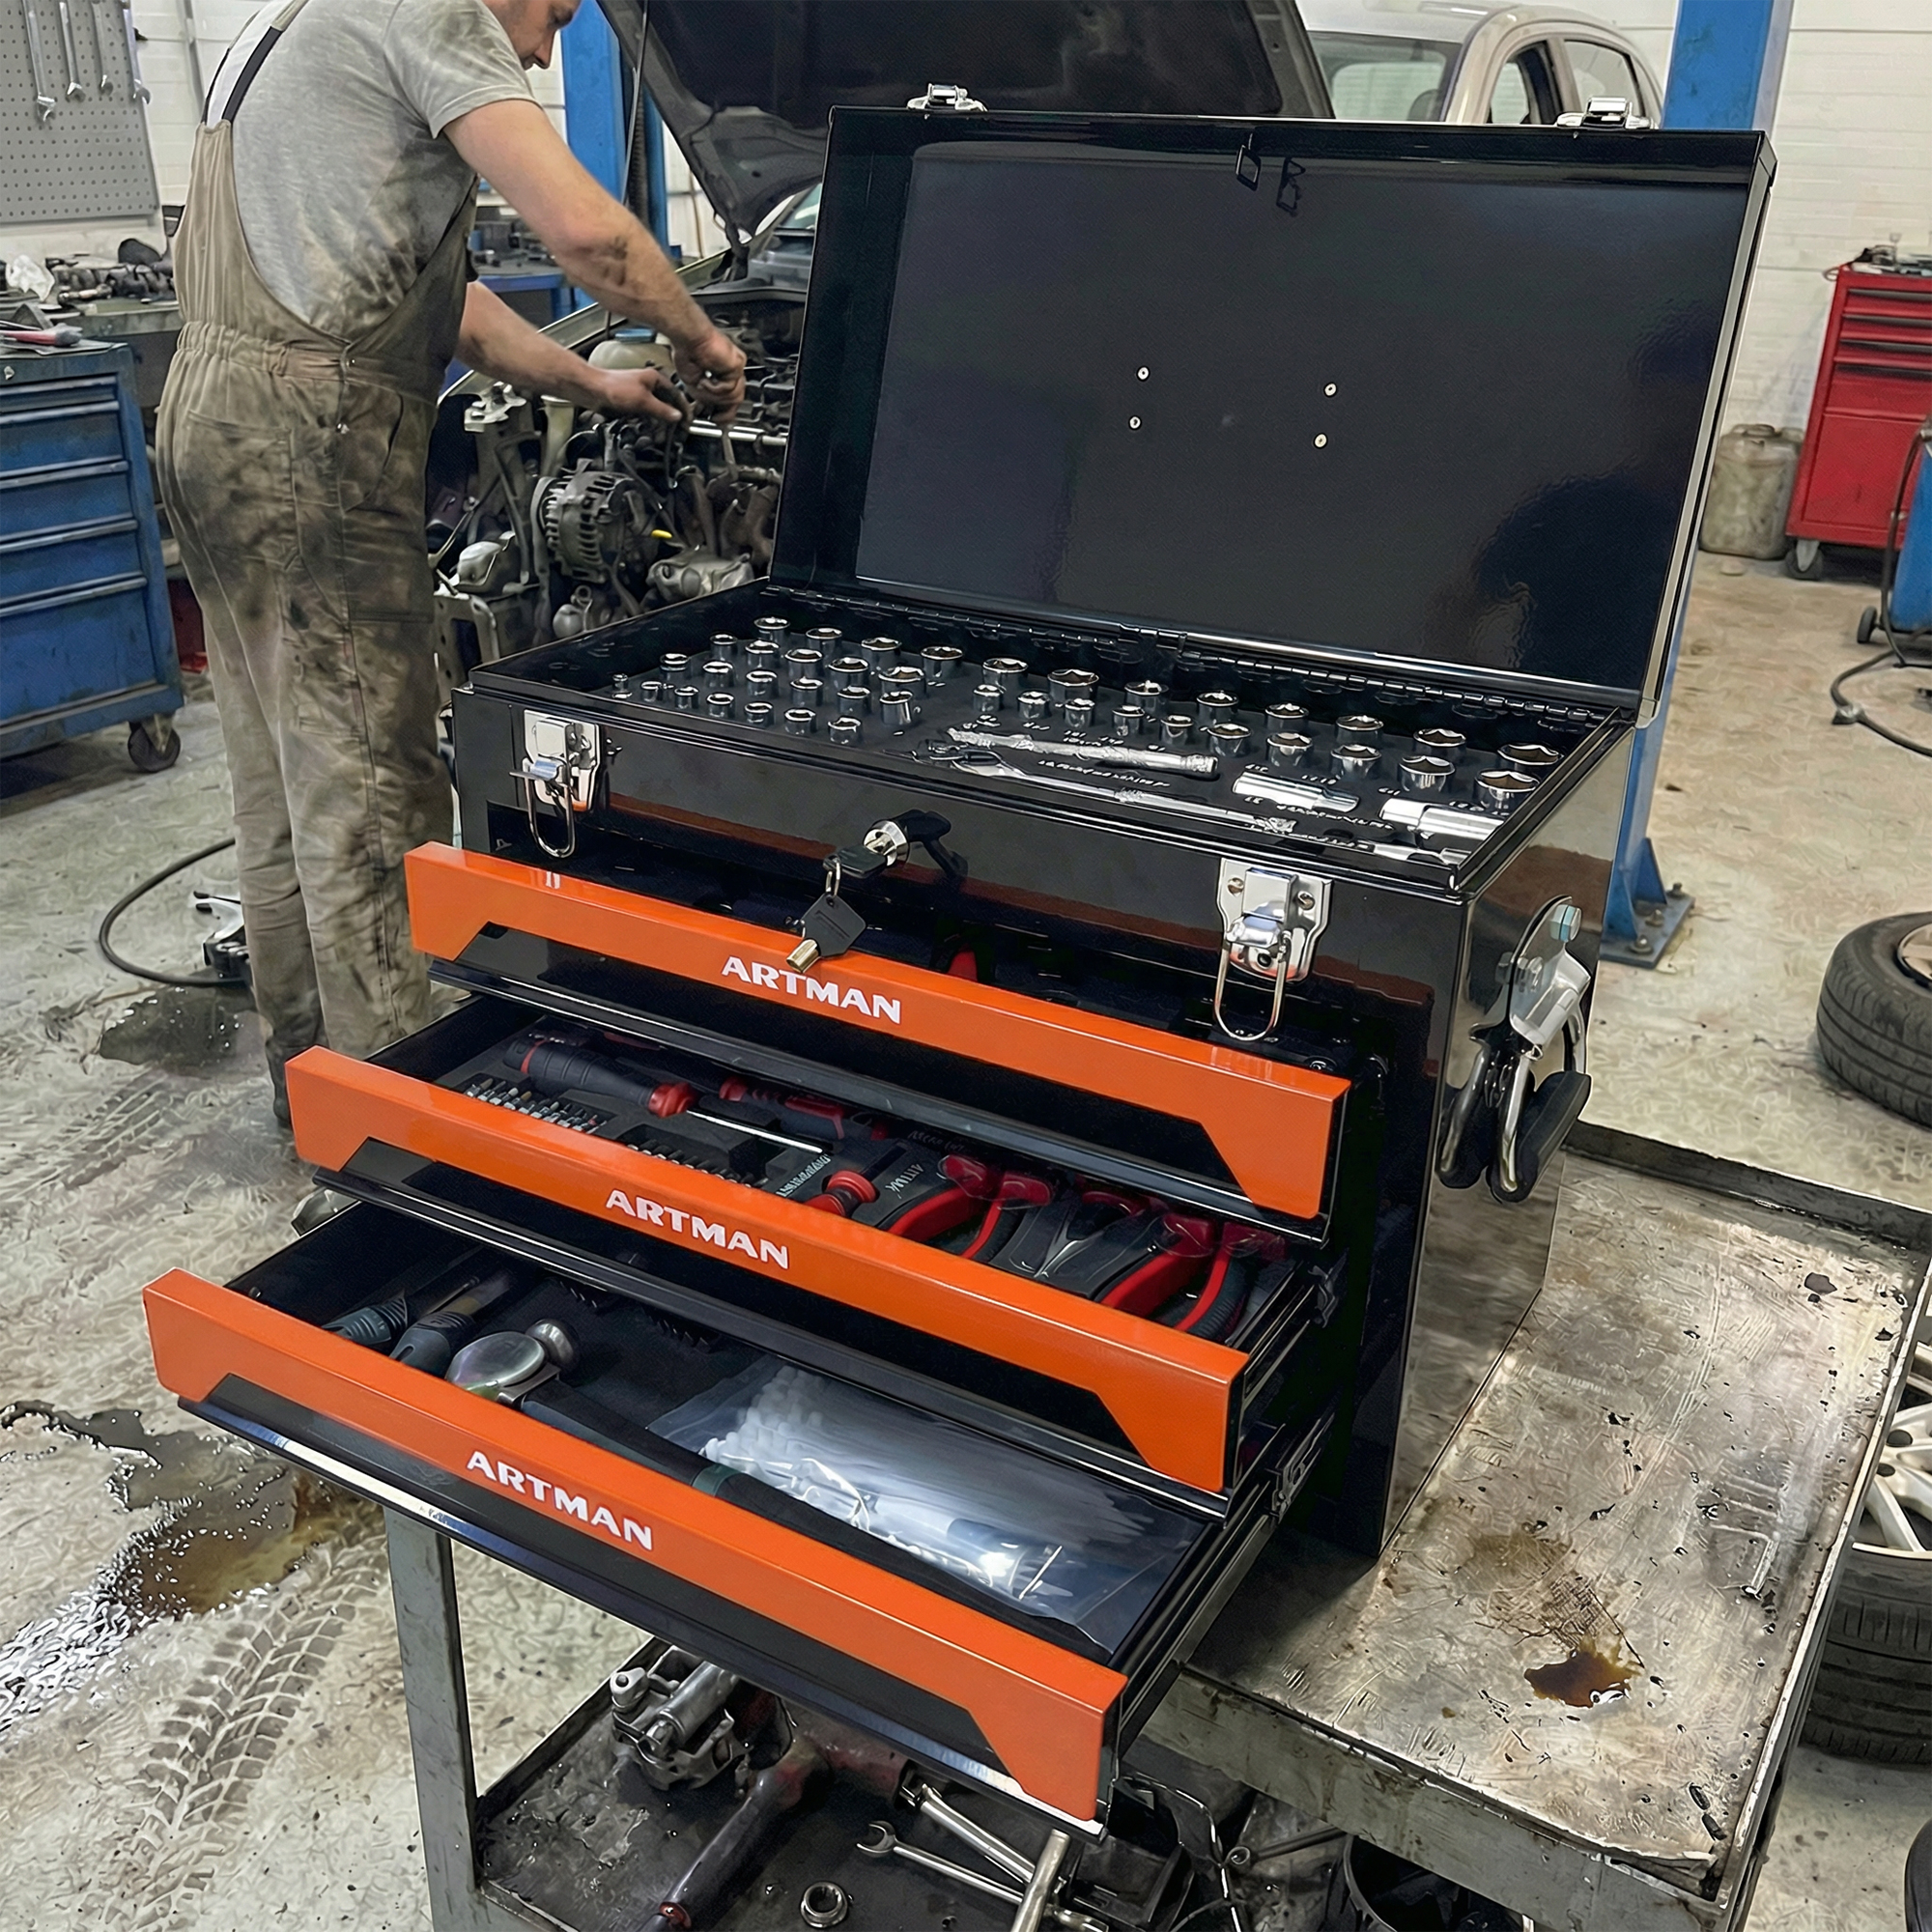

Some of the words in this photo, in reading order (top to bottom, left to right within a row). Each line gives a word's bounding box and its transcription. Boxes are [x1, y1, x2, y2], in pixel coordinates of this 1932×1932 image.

[722, 956, 901, 1024] ARTMAN
[606, 1189, 788, 1269] ARTMAN
[467, 1451, 652, 1550] ARTMAN
